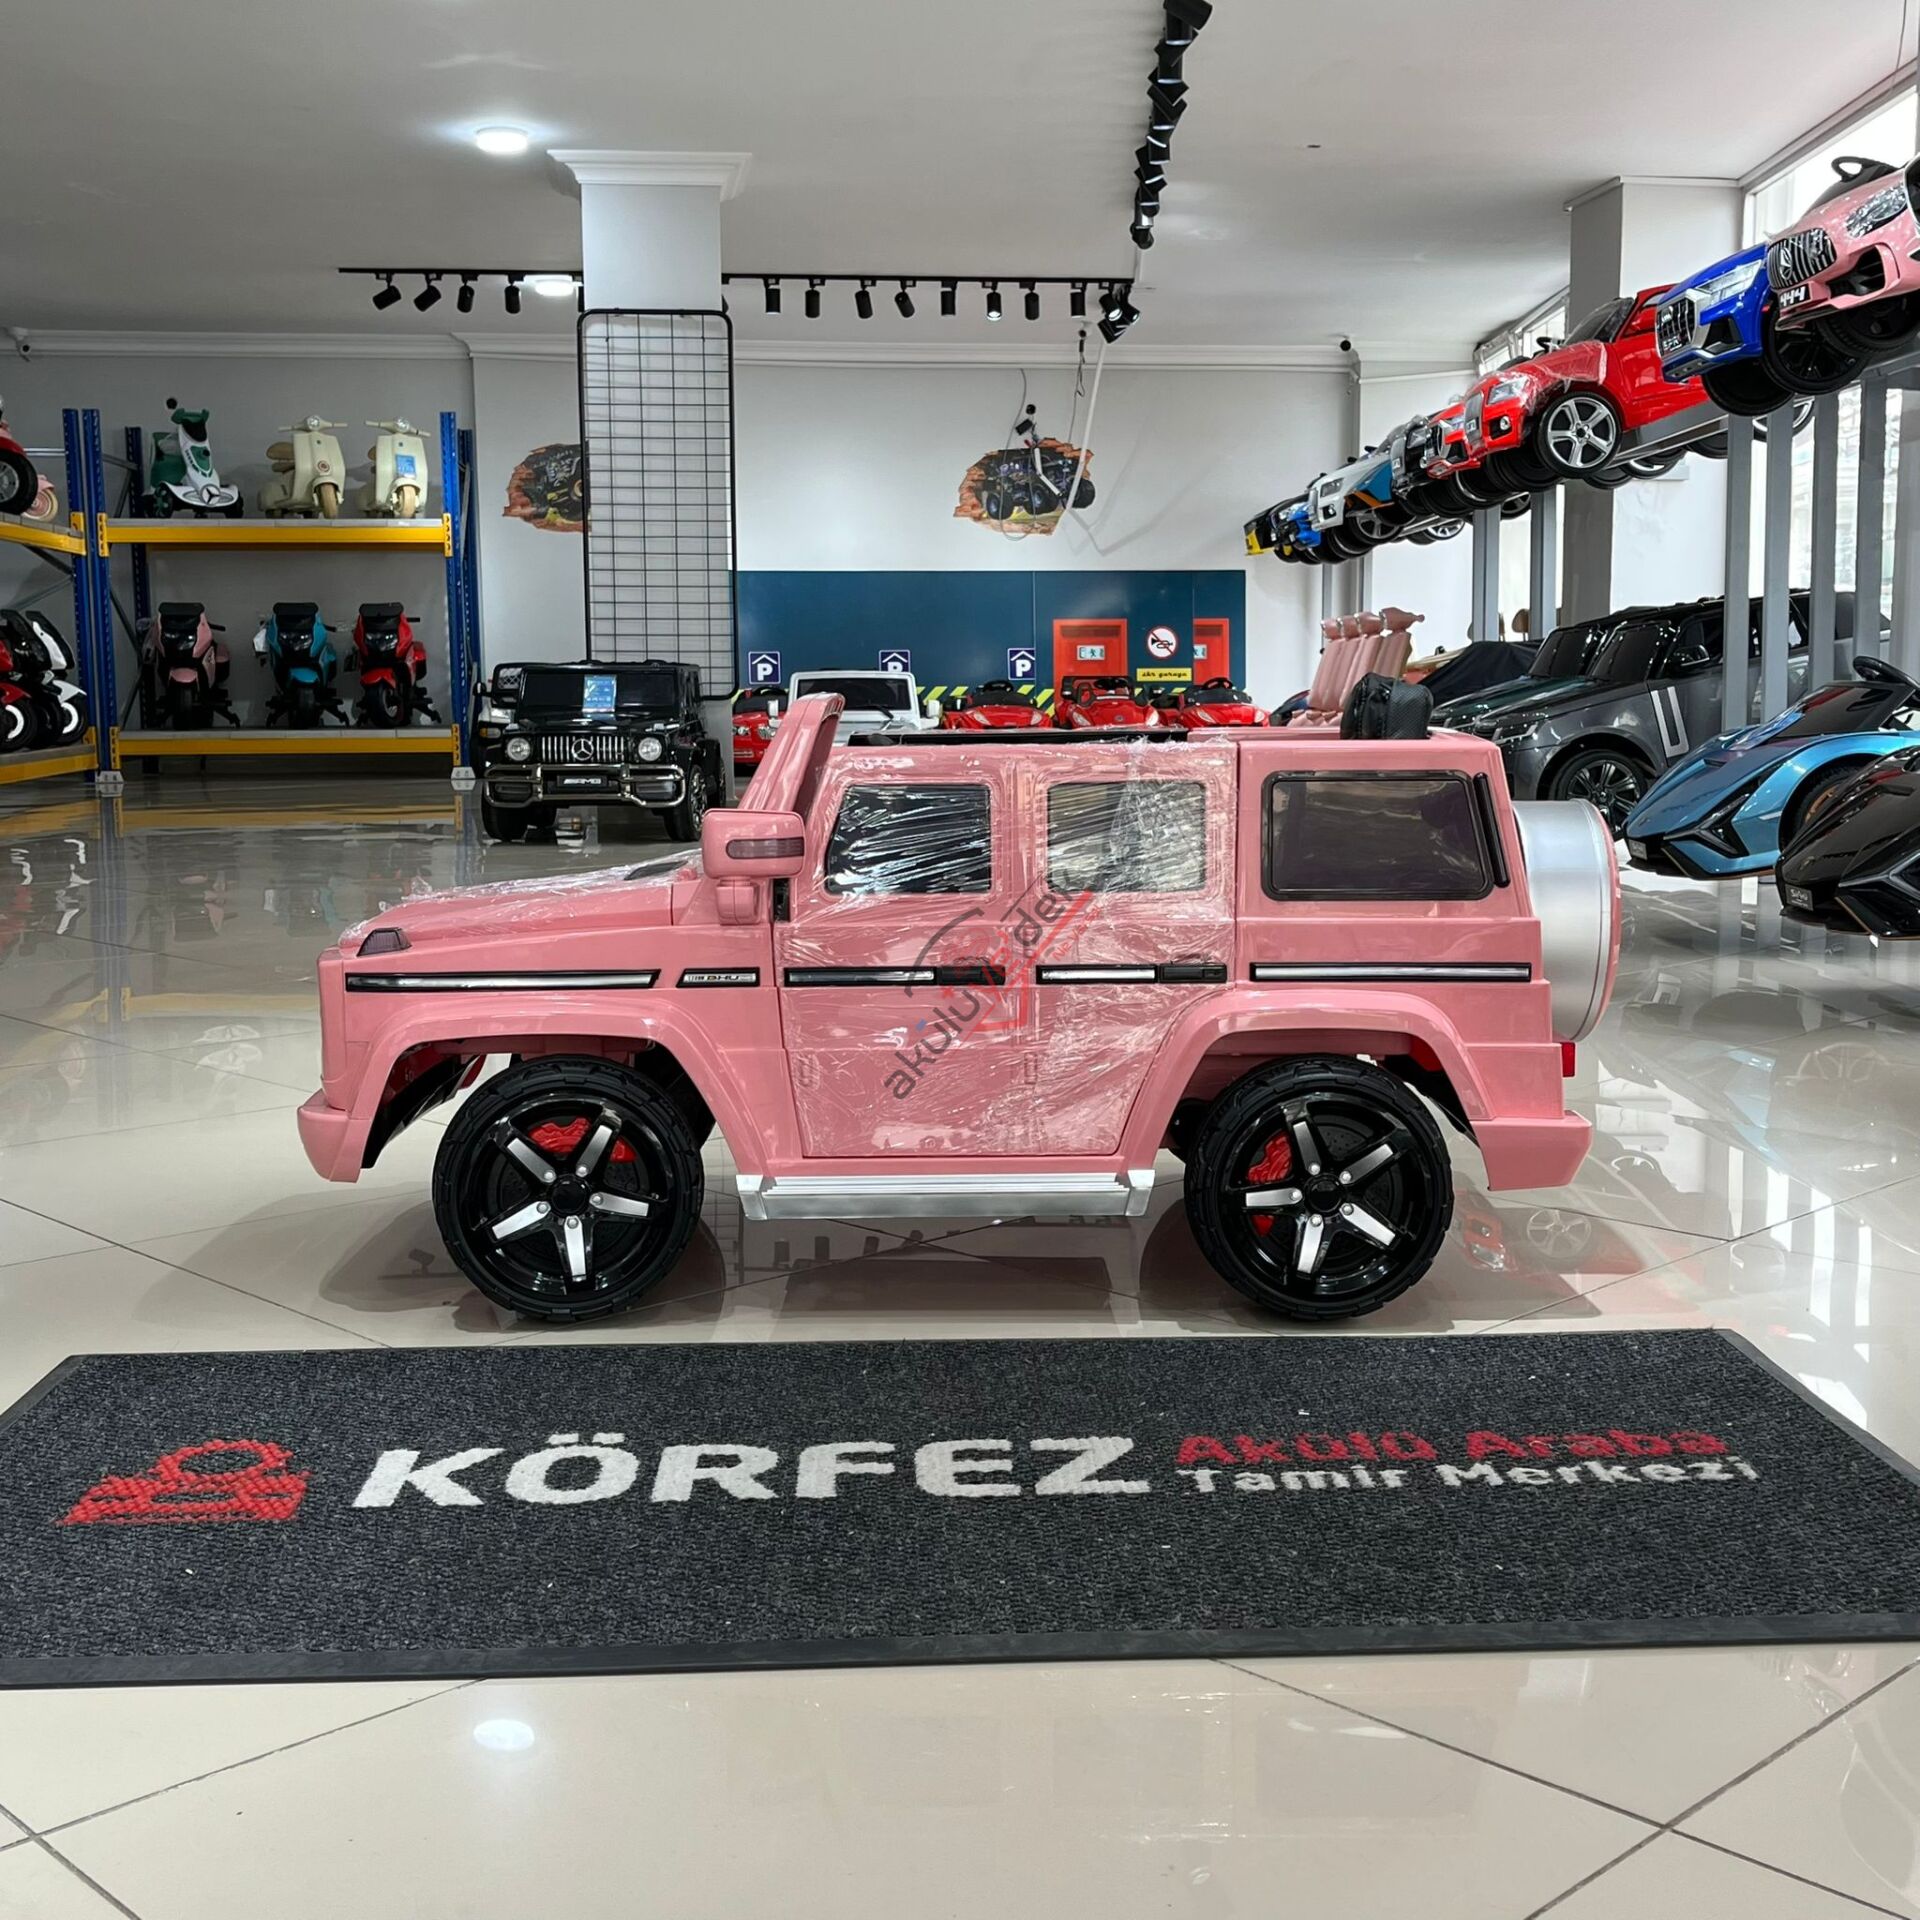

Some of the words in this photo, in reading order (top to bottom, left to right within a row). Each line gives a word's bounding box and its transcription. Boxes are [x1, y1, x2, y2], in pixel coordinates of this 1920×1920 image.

[1780, 286, 1806, 307] 444
[757, 663, 773, 681] P
[1015, 659, 1032, 677] P
[1466, 1429, 1727, 1460] Araba
[352, 1432, 1150, 1507] KÖRFEZ
[1176, 1464, 1408, 1492] Tamir
[1436, 1455, 1759, 1487] Merkezi
